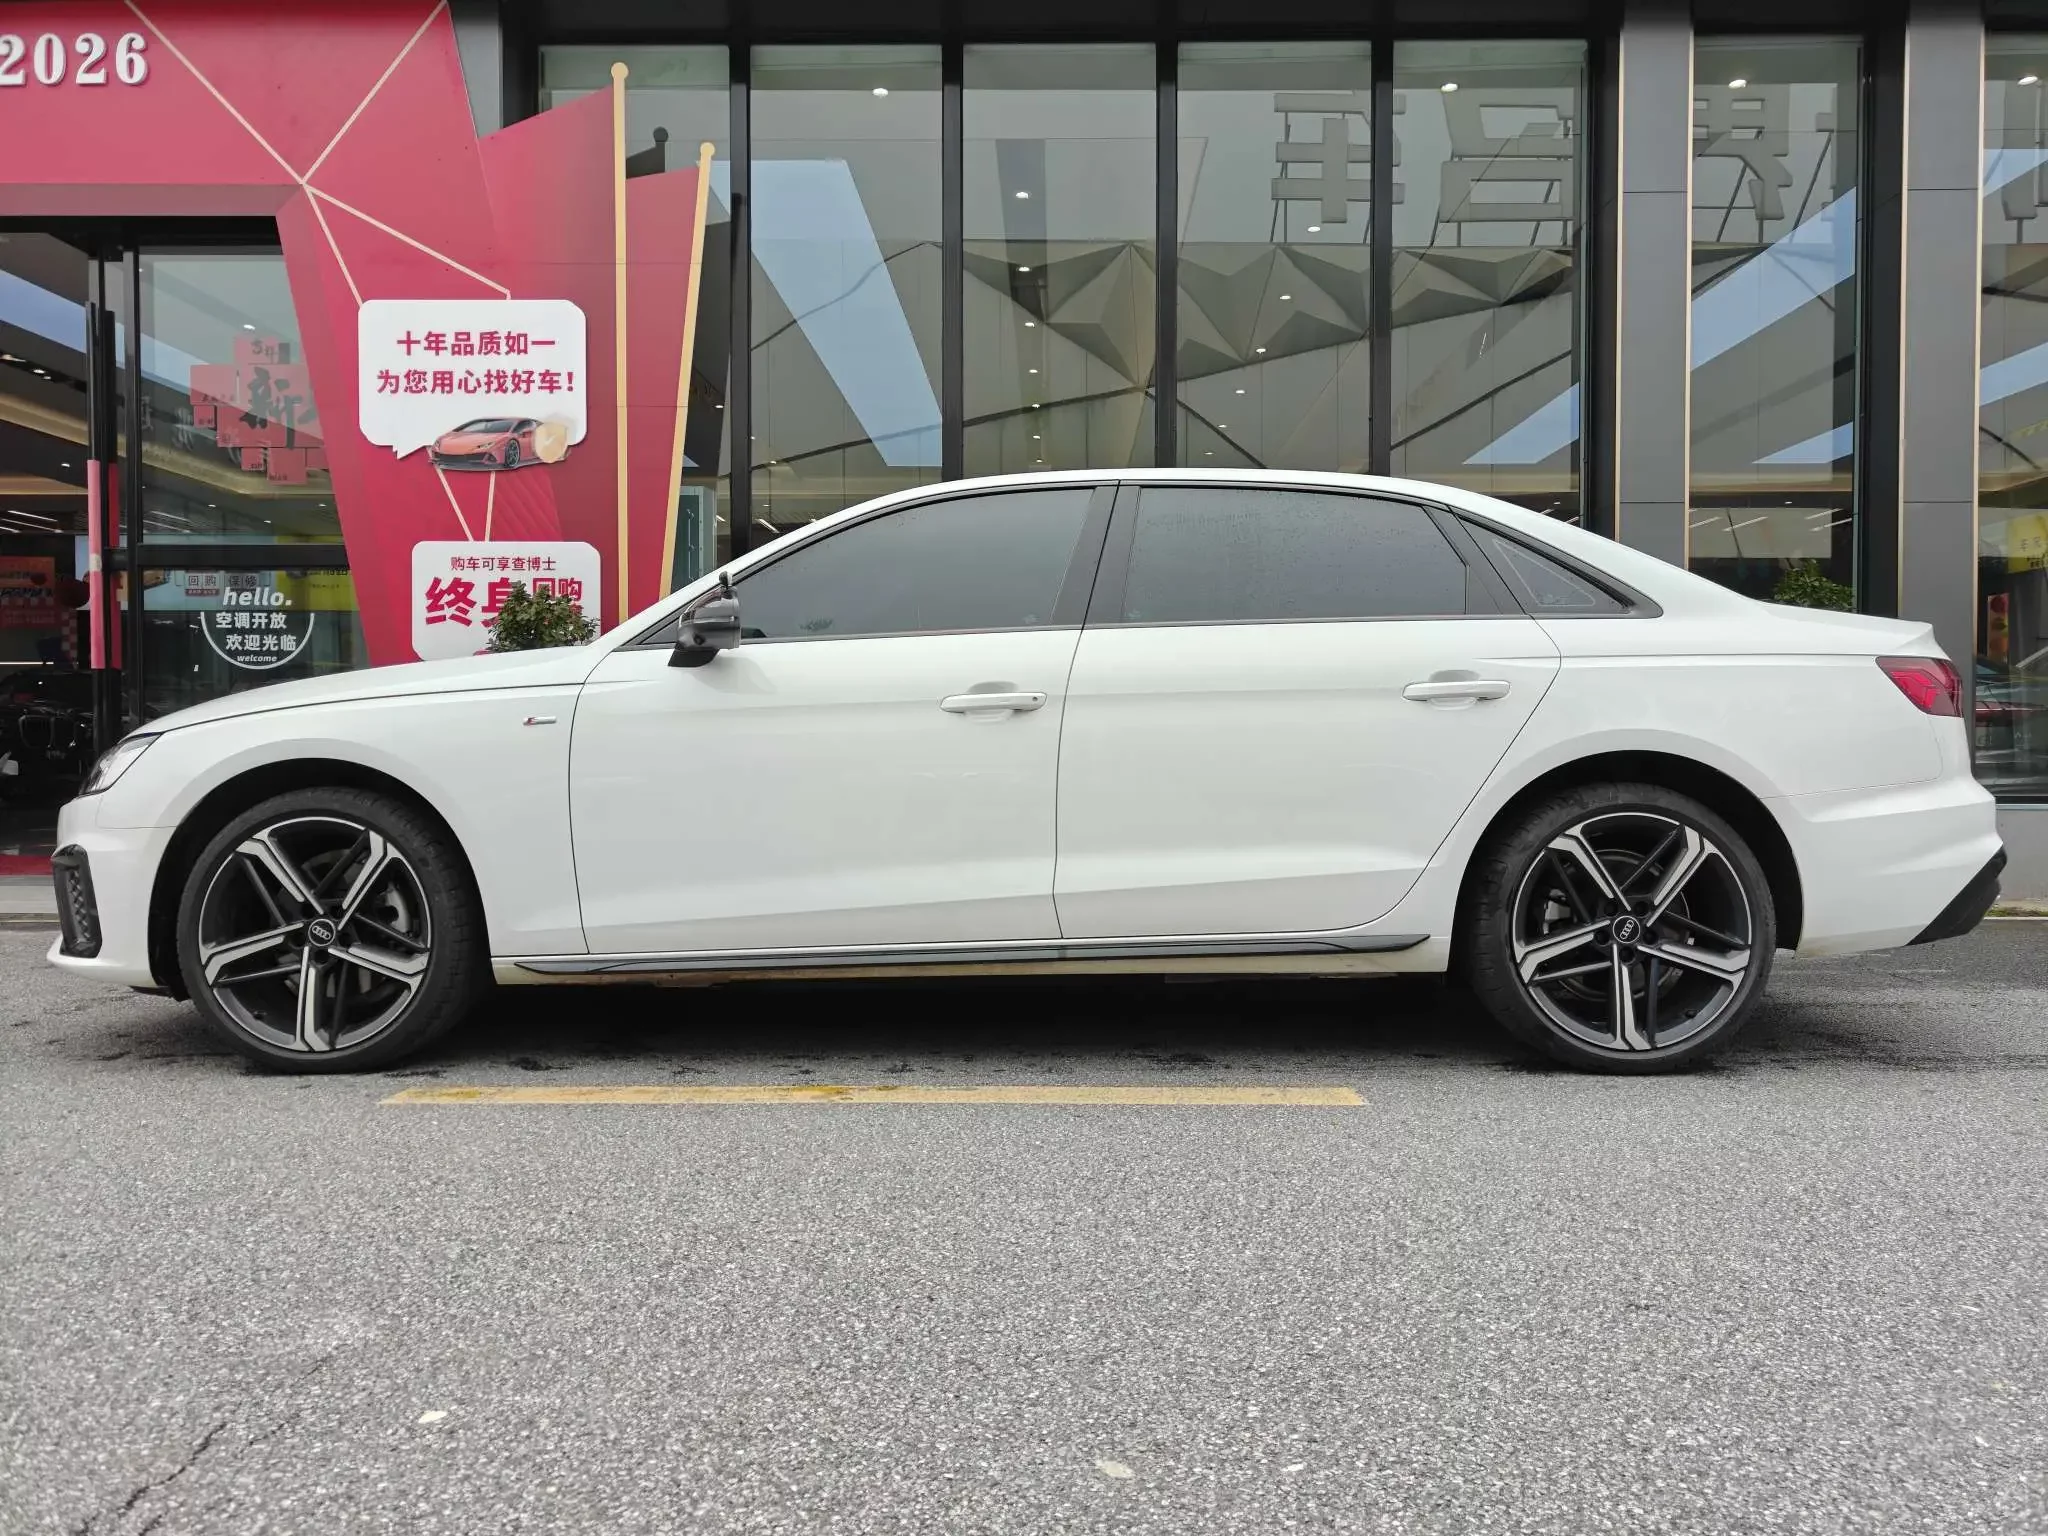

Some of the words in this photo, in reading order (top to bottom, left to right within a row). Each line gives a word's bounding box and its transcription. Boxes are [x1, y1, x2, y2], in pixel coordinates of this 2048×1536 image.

[0, 32, 148, 86] 2026
[396, 330, 556, 356] 十年品质如一
[376, 369, 576, 395] 为您用心找好车!
[450, 556, 557, 572] 购车可享查博士
[222, 587, 292, 606] hello.
[215, 611, 288, 629] 空调开放
[225, 634, 298, 652] 欢迎光临
[236, 654, 278, 663] welcome
